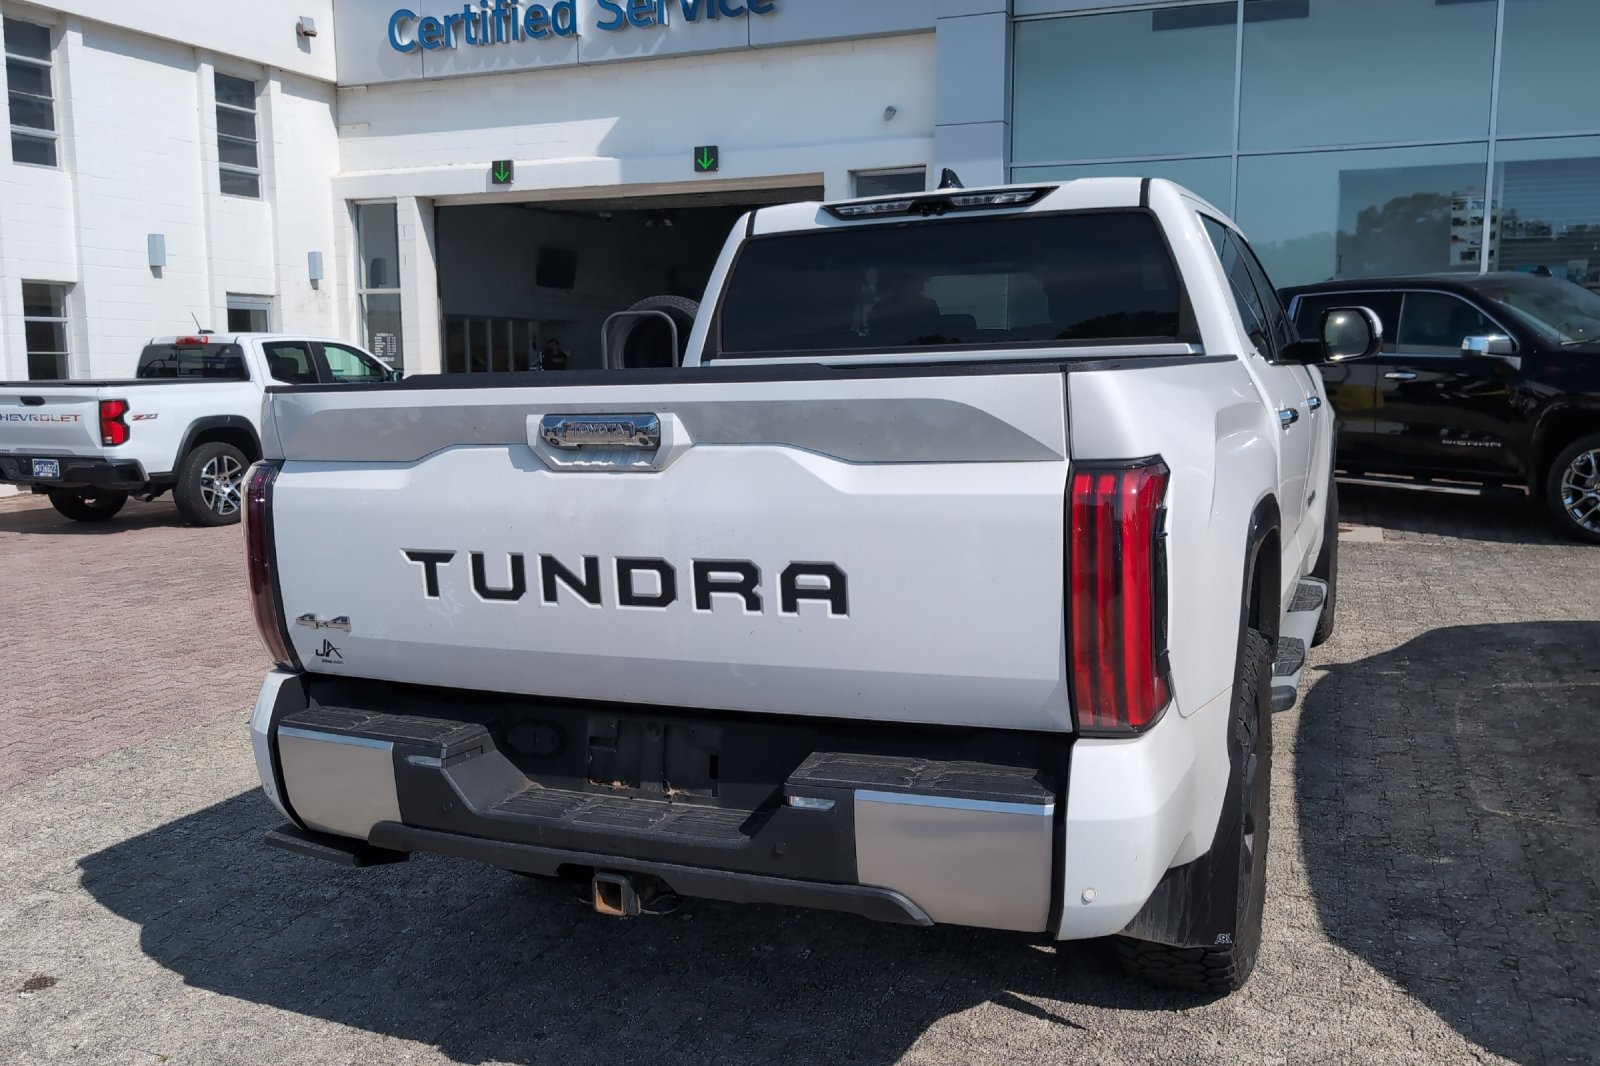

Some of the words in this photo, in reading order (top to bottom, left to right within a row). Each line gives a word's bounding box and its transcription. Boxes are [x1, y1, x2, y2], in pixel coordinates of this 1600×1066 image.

[387, 0, 579, 53] Certified
[0, 413, 82, 422] HEVROLET
[573, 423, 626, 436] TOYOTA
[400, 548, 850, 619] TUNDRA
